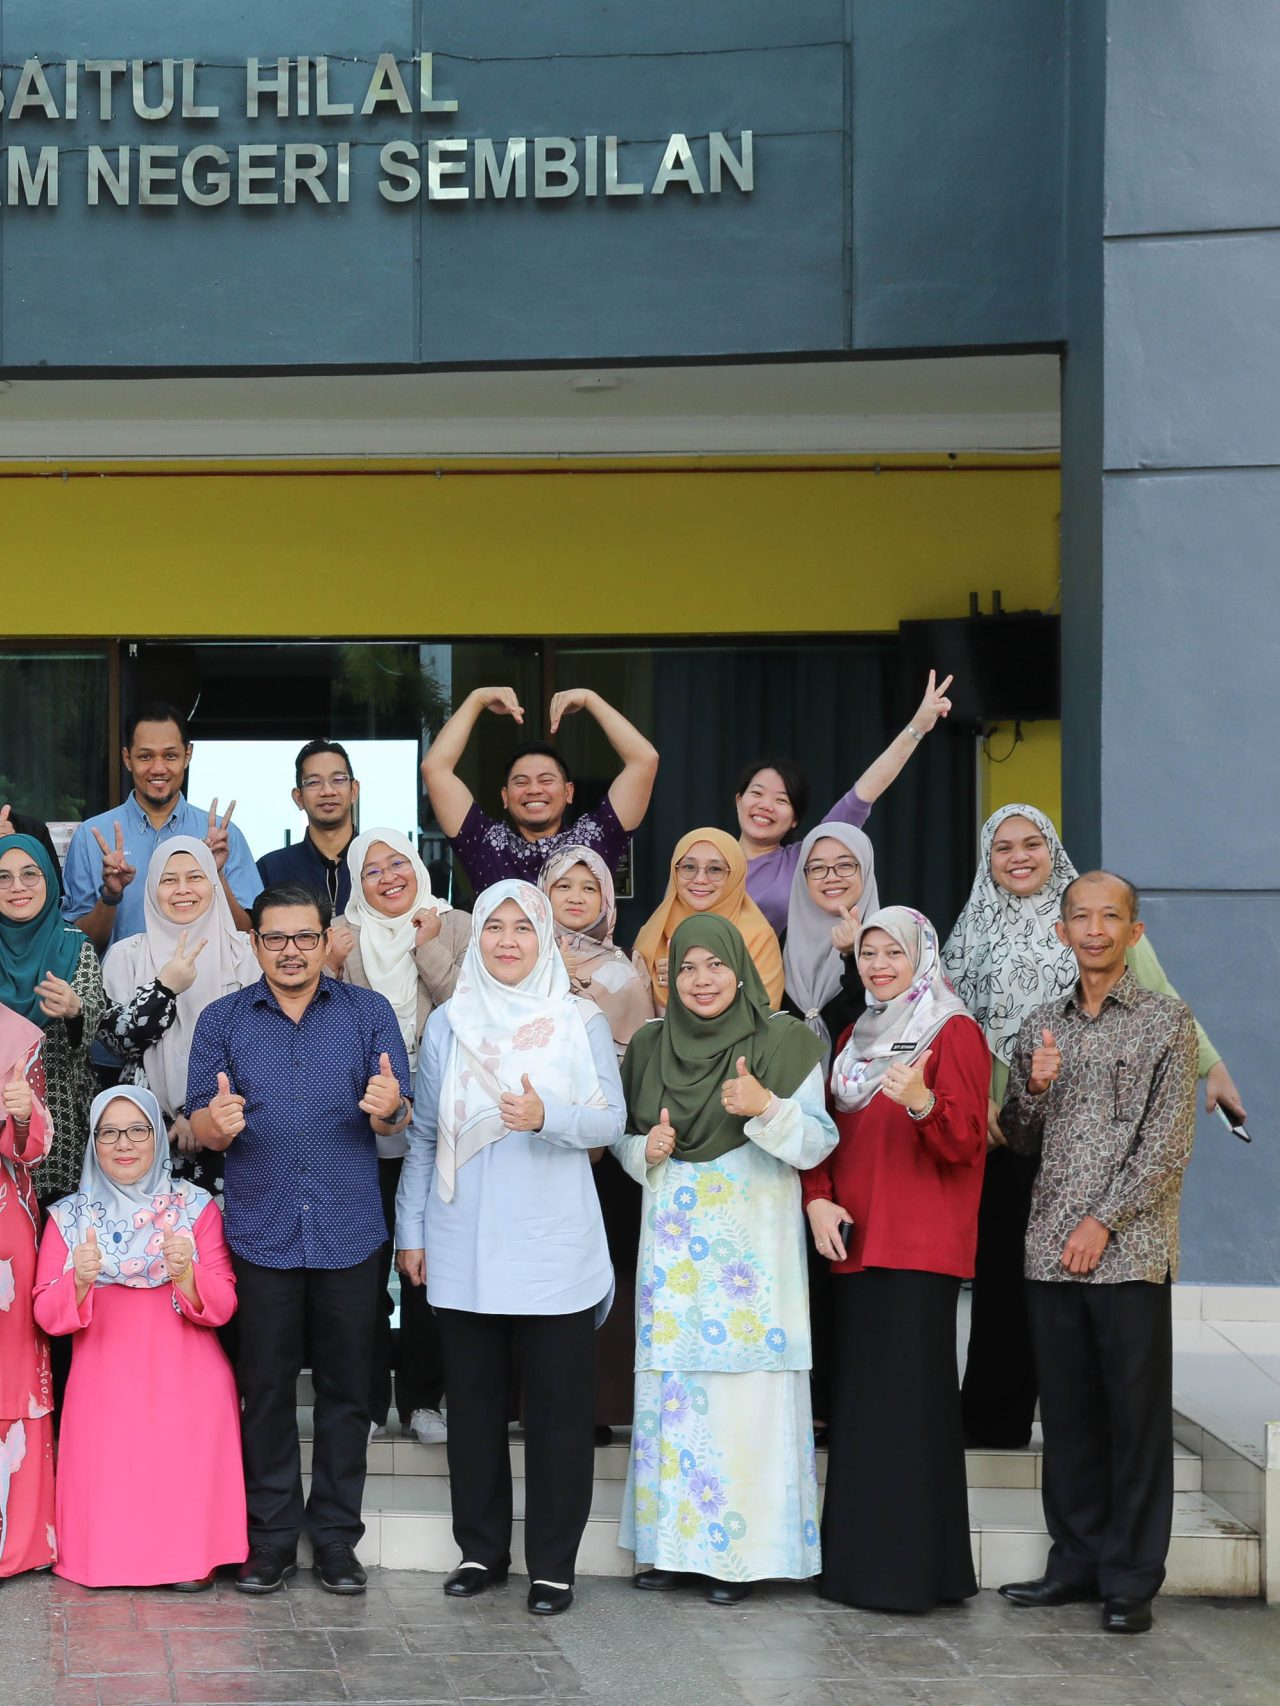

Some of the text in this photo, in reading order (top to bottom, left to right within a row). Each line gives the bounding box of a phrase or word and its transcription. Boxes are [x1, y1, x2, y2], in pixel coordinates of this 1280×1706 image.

[246, 53, 458, 118] HILAL
[87, 143, 349, 206] NEGERI
[378, 130, 754, 203] SEMBILAN
